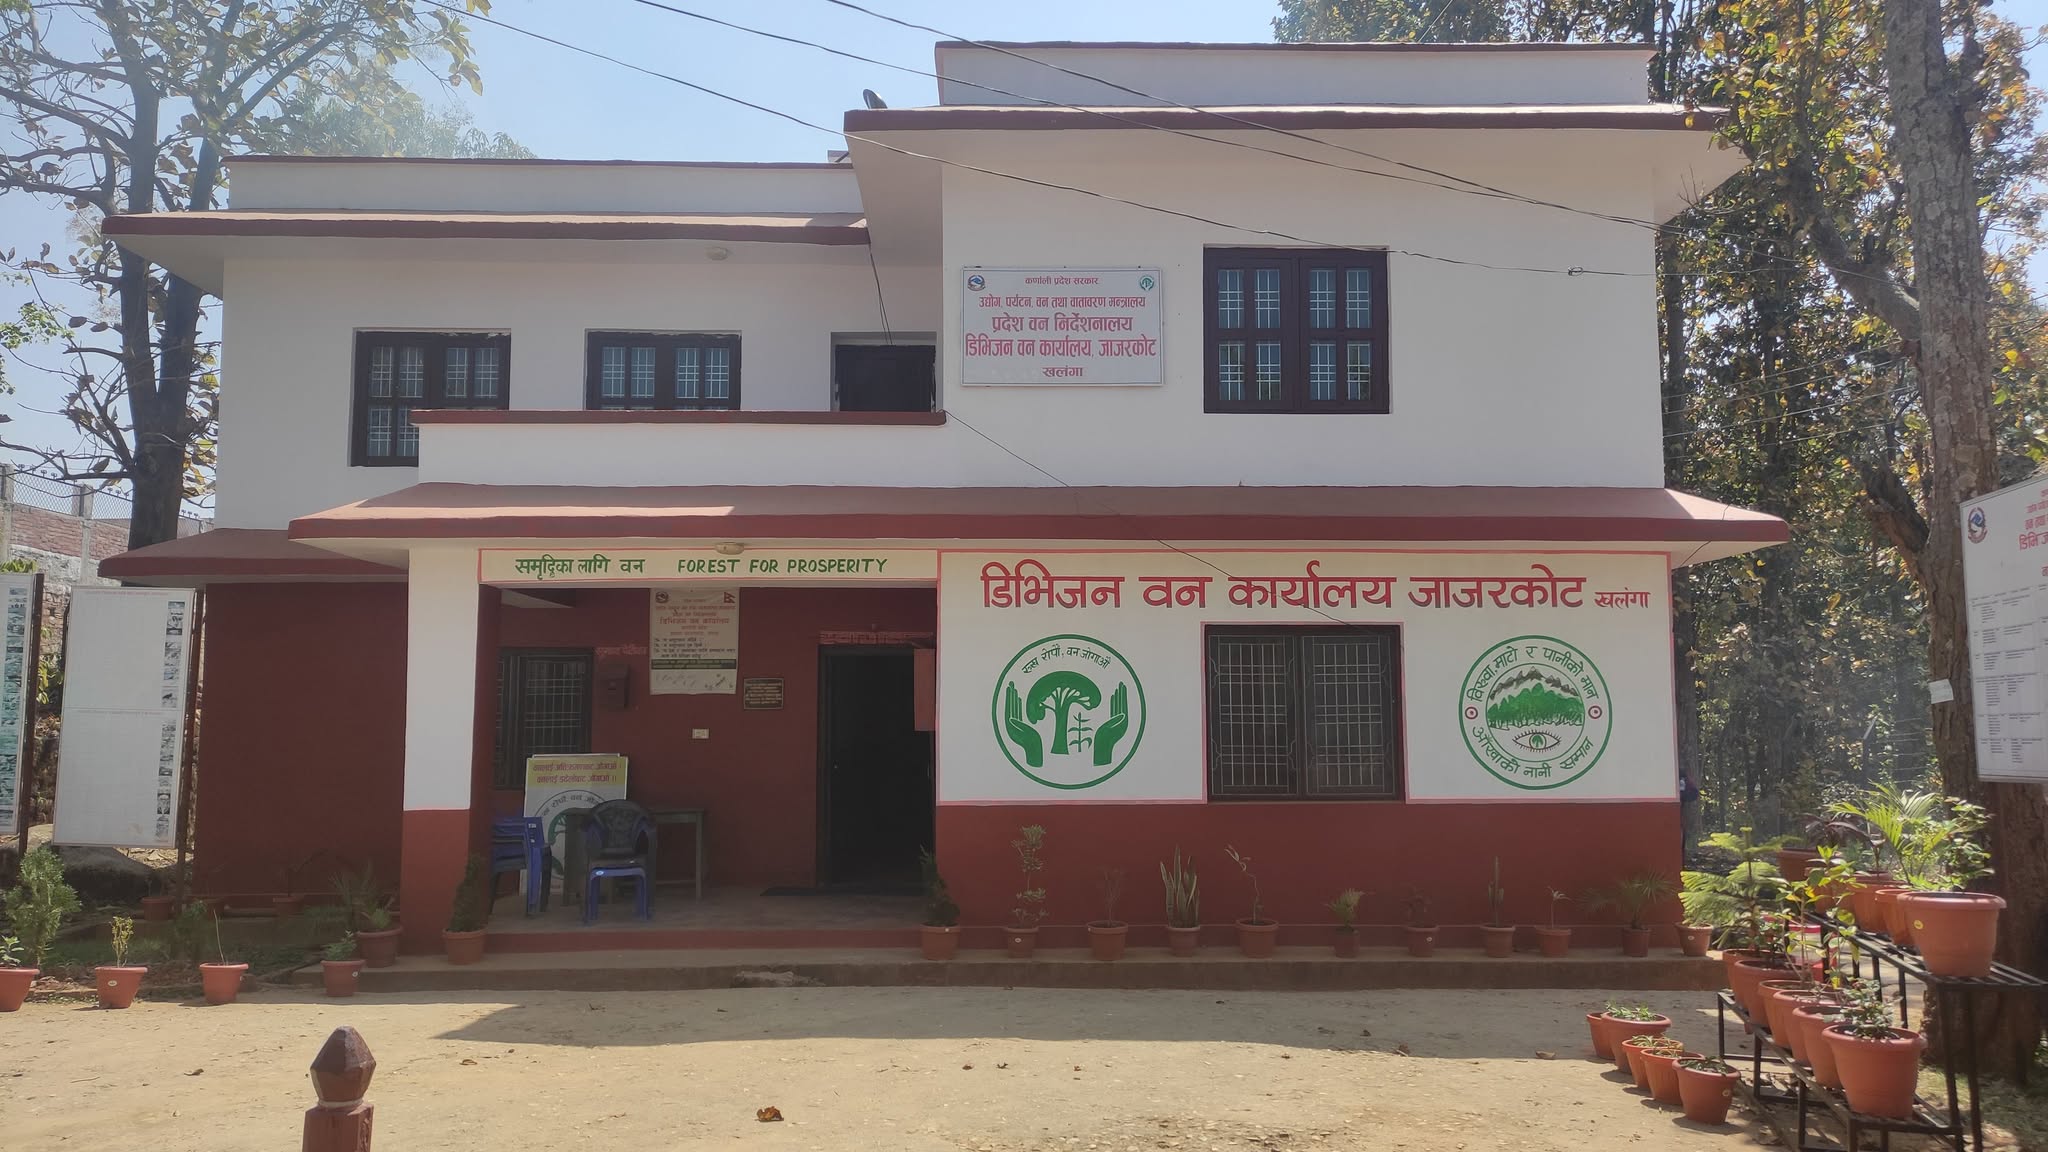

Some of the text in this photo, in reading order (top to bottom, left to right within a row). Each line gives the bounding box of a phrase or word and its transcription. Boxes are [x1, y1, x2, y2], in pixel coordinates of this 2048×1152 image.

[1054, 275, 1071, 286] प्रदेश
[1073, 277, 1099, 286] सरकार
[1036, 296, 1049, 308] वन
[1051, 296, 1068, 309] तथा
[1070, 296, 1106, 308] वातावरण
[1109, 296, 1146, 309] मन्त्रालय
[992, 312, 1133, 332] प्रदेश वन निर्देशनालय
[966, 333, 1157, 358] डिभिजन वन कार्यालय, जाजरकोट
[1042, 365, 1083, 377] खलंगा
[578, 554, 611, 574] लागि
[619, 559, 645, 573] वन
[677, 557, 888, 574] FOREST FOR PROSPERITY
[980, 559, 1651, 609] डिभिजन वन कार्यालय जाजरकोट खलंगा
[1066, 647, 1081, 657] वन
[1493, 645, 1519, 669] माटो
[1525, 645, 1538, 658] र
[1542, 646, 1586, 677] पानीको
[1580, 674, 1599, 700] मान
[1523, 762, 1553, 778] नानी
[1559, 735, 1594, 770] समान
